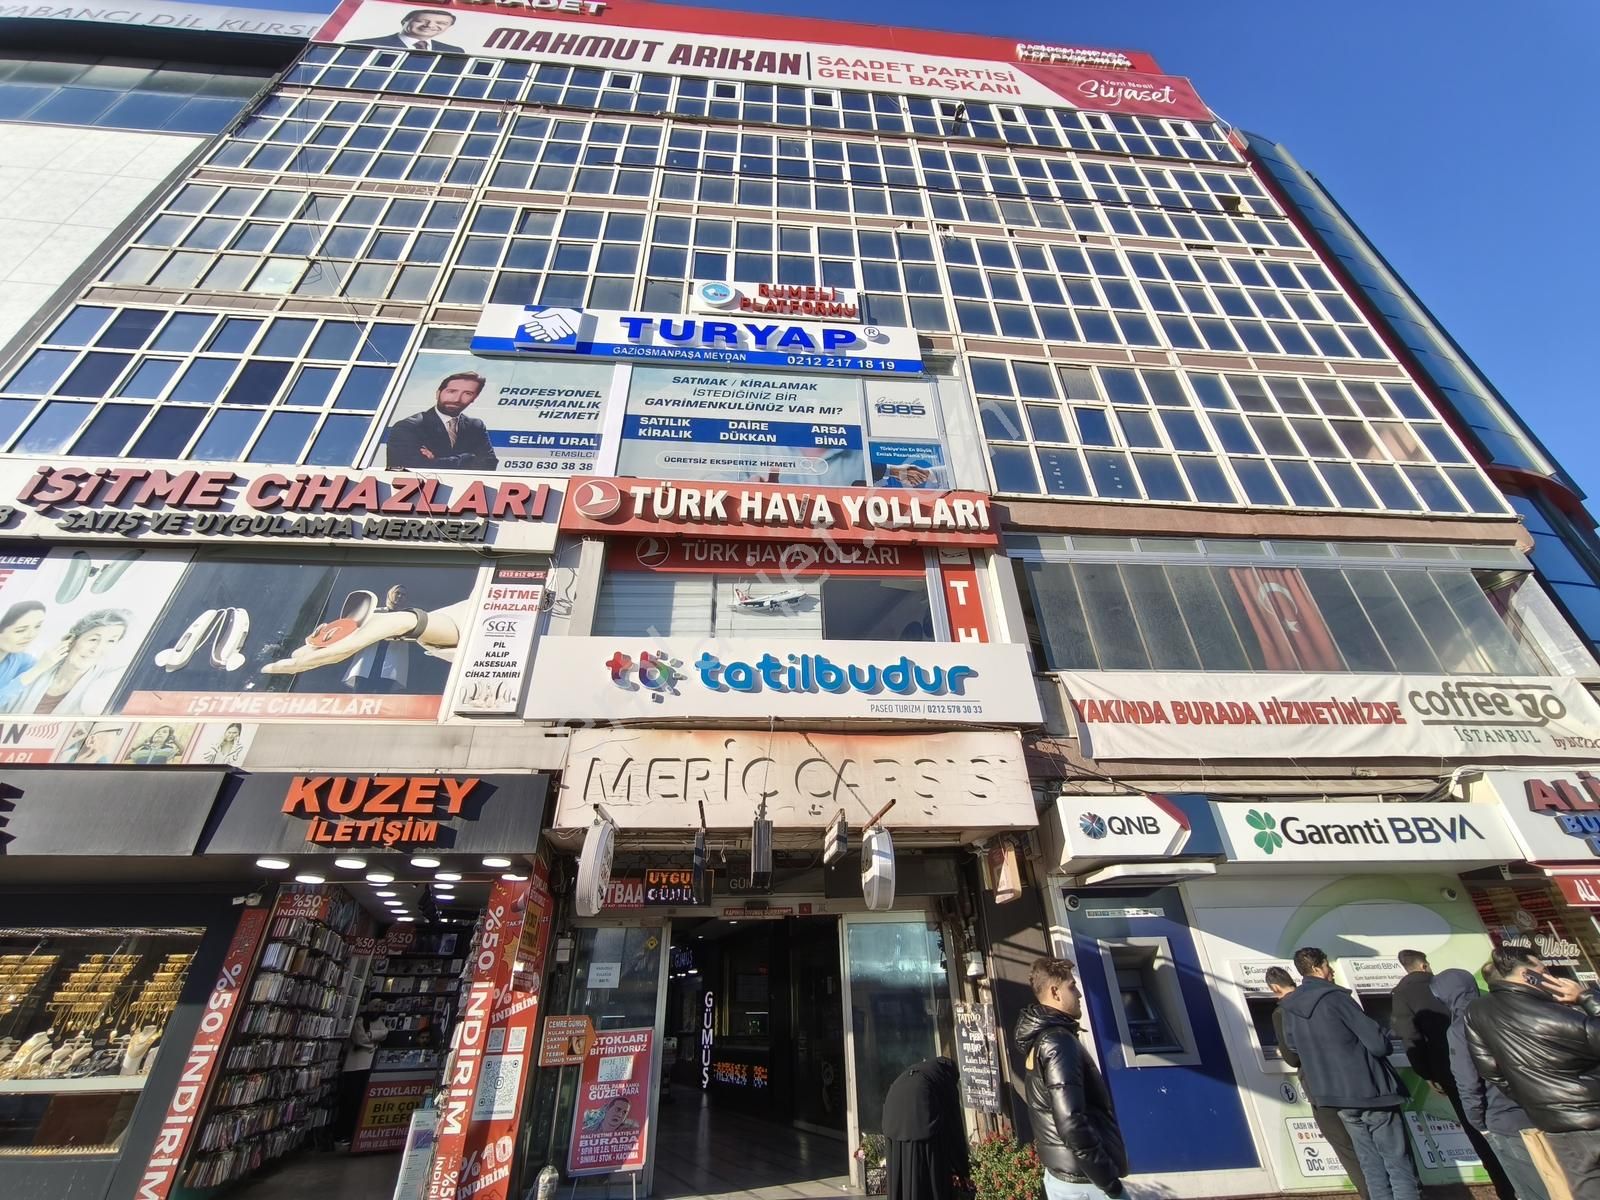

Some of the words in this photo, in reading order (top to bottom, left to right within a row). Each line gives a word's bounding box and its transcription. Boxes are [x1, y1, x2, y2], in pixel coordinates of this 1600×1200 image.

[482, 27, 664, 63] MAHMUT
[667, 43, 801, 75] ARIKAN
[817, 56, 914, 72] SAADET
[923, 65, 1016, 83] PARTİSİ
[818, 68, 902, 84] GENEL
[909, 75, 1021, 95] BAŞKANI
[740, 297, 857, 318] PLATFORMU
[619, 316, 857, 354] TURYAP
[612, 346, 701, 360] GAZİOSMANPAŞA
[703, 352, 747, 362] MEYDAN
[787, 356, 822, 367] 0212
[826, 358, 851, 368] 217
[857, 360, 874, 369] 18
[879, 361, 897, 371] 19
[672, 376, 729, 387] SATMAK
[740, 378, 818, 391] KİRALAMAK
[500, 387, 602, 398] PROFESYONEL
[776, 391, 797, 401] BİR
[498, 398, 602, 409] DANIŞMANLIK
[644, 396, 784, 412] GAYRİMENKULÜNÜZ
[788, 406, 814, 414] VAR
[818, 407, 843, 415] MI?
[875, 403, 926, 416] 1985
[538, 410, 600, 421] HİZMETİ
[639, 416, 691, 427] SATILIK
[728, 420, 769, 432] DAİRE
[811, 425, 847, 435] ARSA
[509, 434, 555, 445] SELİM
[559, 437, 598, 447] URAL
[637, 427, 693, 439] KİRALIK
[719, 432, 777, 442] DÜKKAN
[815, 434, 848, 446] BİNA
[504, 461, 533, 469] 0530
[536, 462, 558, 470] 630
[579, 463, 593, 471] 38
[664, 456, 708, 464] ÜCRETSİZ
[710, 459, 758, 467] EKSPERTİZ
[760, 460, 796, 469] HİZMETİ
[16, 465, 238, 514] İŞİTME
[245, 472, 552, 520] CİHAZLARI
[630, 481, 728, 522] TÜRK
[740, 490, 834, 526] HAVA
[843, 495, 990, 530] YOLLARI
[54, 511, 144, 535] SATIŞ
[151, 512, 190, 532] VE
[193, 513, 353, 537] UYGULAMA
[362, 517, 490, 543] MERKEZİ
[682, 538, 740, 562] TÜRK
[747, 544, 812, 564] HAVA
[812, 546, 900, 566] YOLLARI
[488, 588, 540, 600] İŞİTME
[483, 603, 540, 612] CİHAZLARI
[486, 621, 518, 632] SGK
[473, 660, 518, 668] AKSESUAR
[695, 652, 978, 693] tatilbudur
[465, 670, 490, 678] CİHAZ
[187, 696, 263, 715] İŞİTME
[267, 698, 383, 714] CİHAZLARI
[1408, 681, 1513, 717] coffee
[928, 705, 944, 714] 0212
[946, 705, 960, 714] 578
[962, 705, 971, 714] 30
[973, 705, 982, 714] 33
[1072, 699, 1171, 723] YAKINDA
[1170, 701, 1261, 725] BURADA
[1259, 696, 1408, 725] HİZMETİNİZDE
[1453, 727, 1541, 743] İSTANBUL
[281, 776, 479, 813] KUZEY
[305, 816, 438, 845] İLETİŞİM
[1108, 816, 1160, 835] QNB
[1280, 816, 1390, 845] Garanti
[1387, 814, 1486, 843] BBVA
[701, 990, 714, 1089] GÜMÜŞ
[443, 981, 494, 1134] İNDİRİM
[590, 1044, 647, 1055] BİTİRİYORUZ
[373, 1104, 394, 1113] BİR
[579, 1136, 638, 1147] BURADA
[1306, 1158, 1325, 1171] DCC
